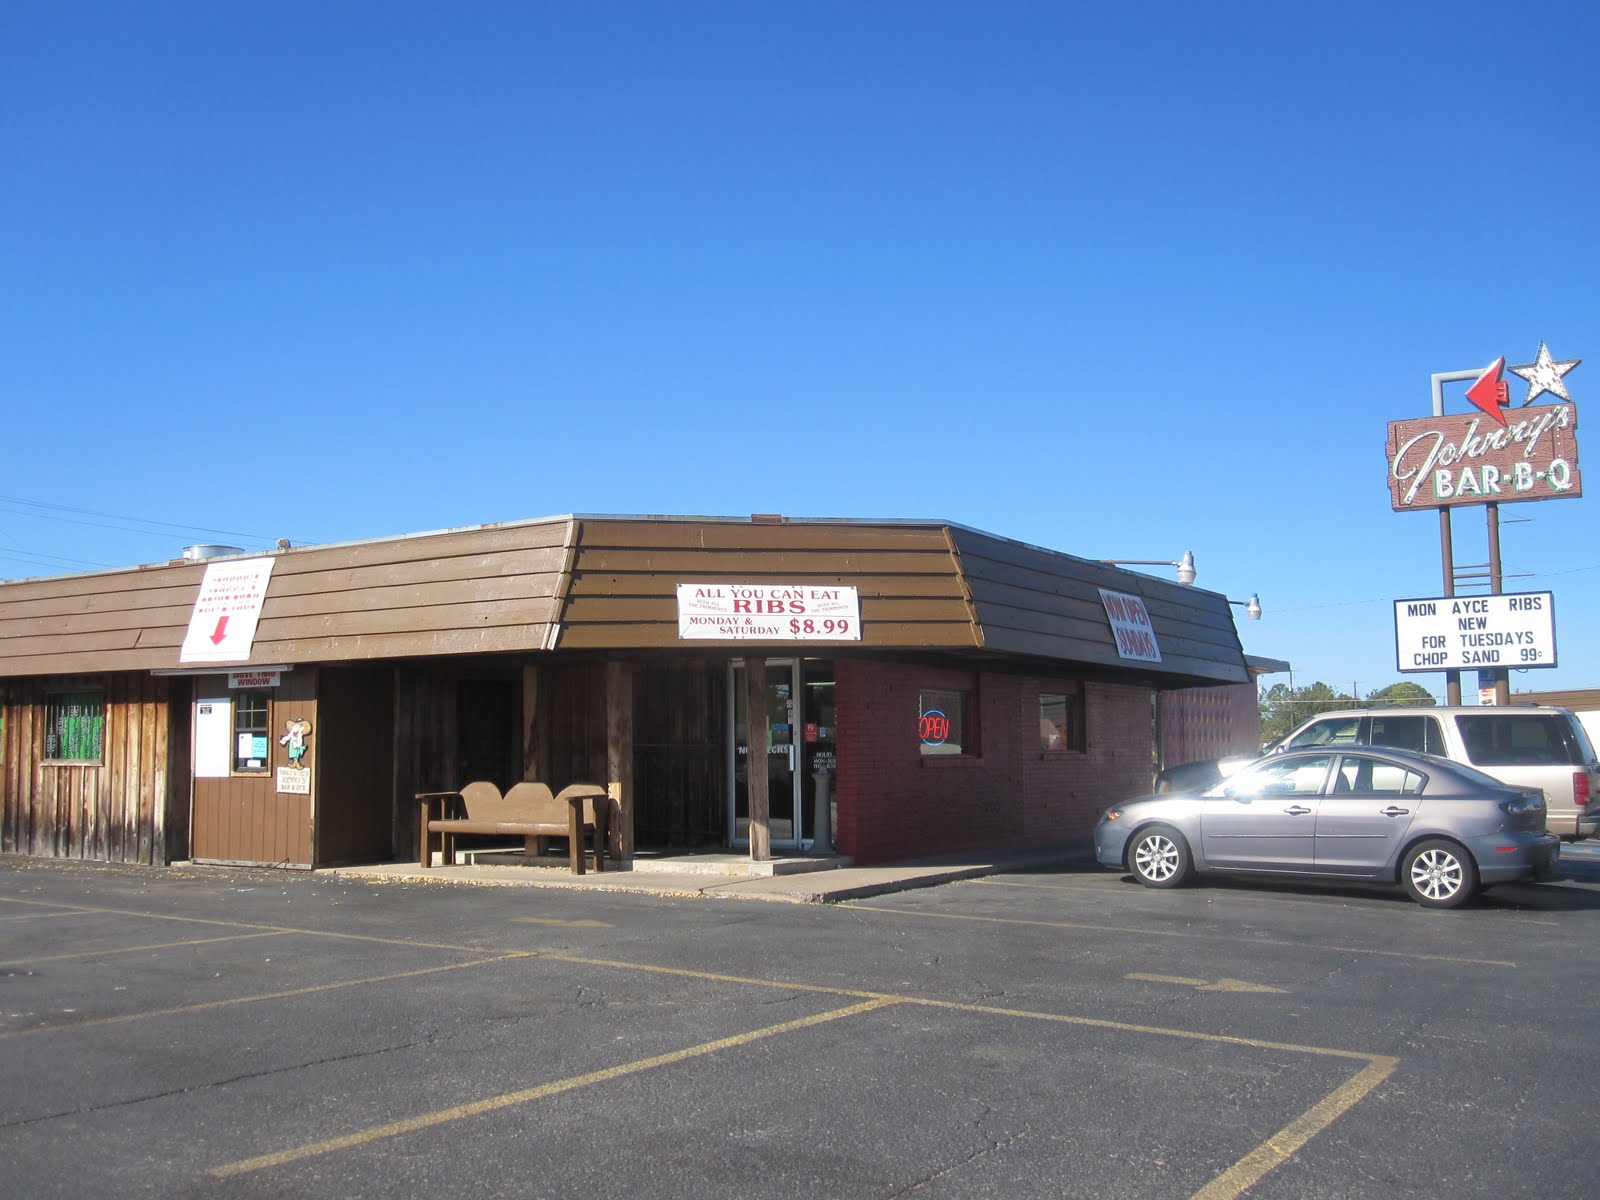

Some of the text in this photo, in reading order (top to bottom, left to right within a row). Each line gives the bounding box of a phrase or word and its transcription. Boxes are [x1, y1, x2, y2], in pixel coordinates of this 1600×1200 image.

[1392, 405, 1570, 505] Johnny's
[1434, 457, 1573, 500] BAR-B-Q
[695, 588, 841, 600] ALL YOU CAN EAT
[699, 604, 728, 613] TRIMMINGS
[733, 599, 806, 614] RIBS
[822, 605, 849, 613] TRIMMINGS
[1407, 596, 1542, 617] MON AYCE RIBS
[689, 617, 753, 626] MONDAY &
[789, 617, 850, 635] $8.99
[1458, 616, 1487, 631] NEW
[719, 626, 781, 635] SATURDAY
[1115, 626, 1158, 659] SUNDAYS
[1422, 631, 1534, 649] FOR TUESDAYS
[1413, 651, 1448, 666] CHOP
[1462, 649, 1500, 664] SAND
[237, 678, 271, 686] WINDOW
[918, 716, 950, 740] OPEN
